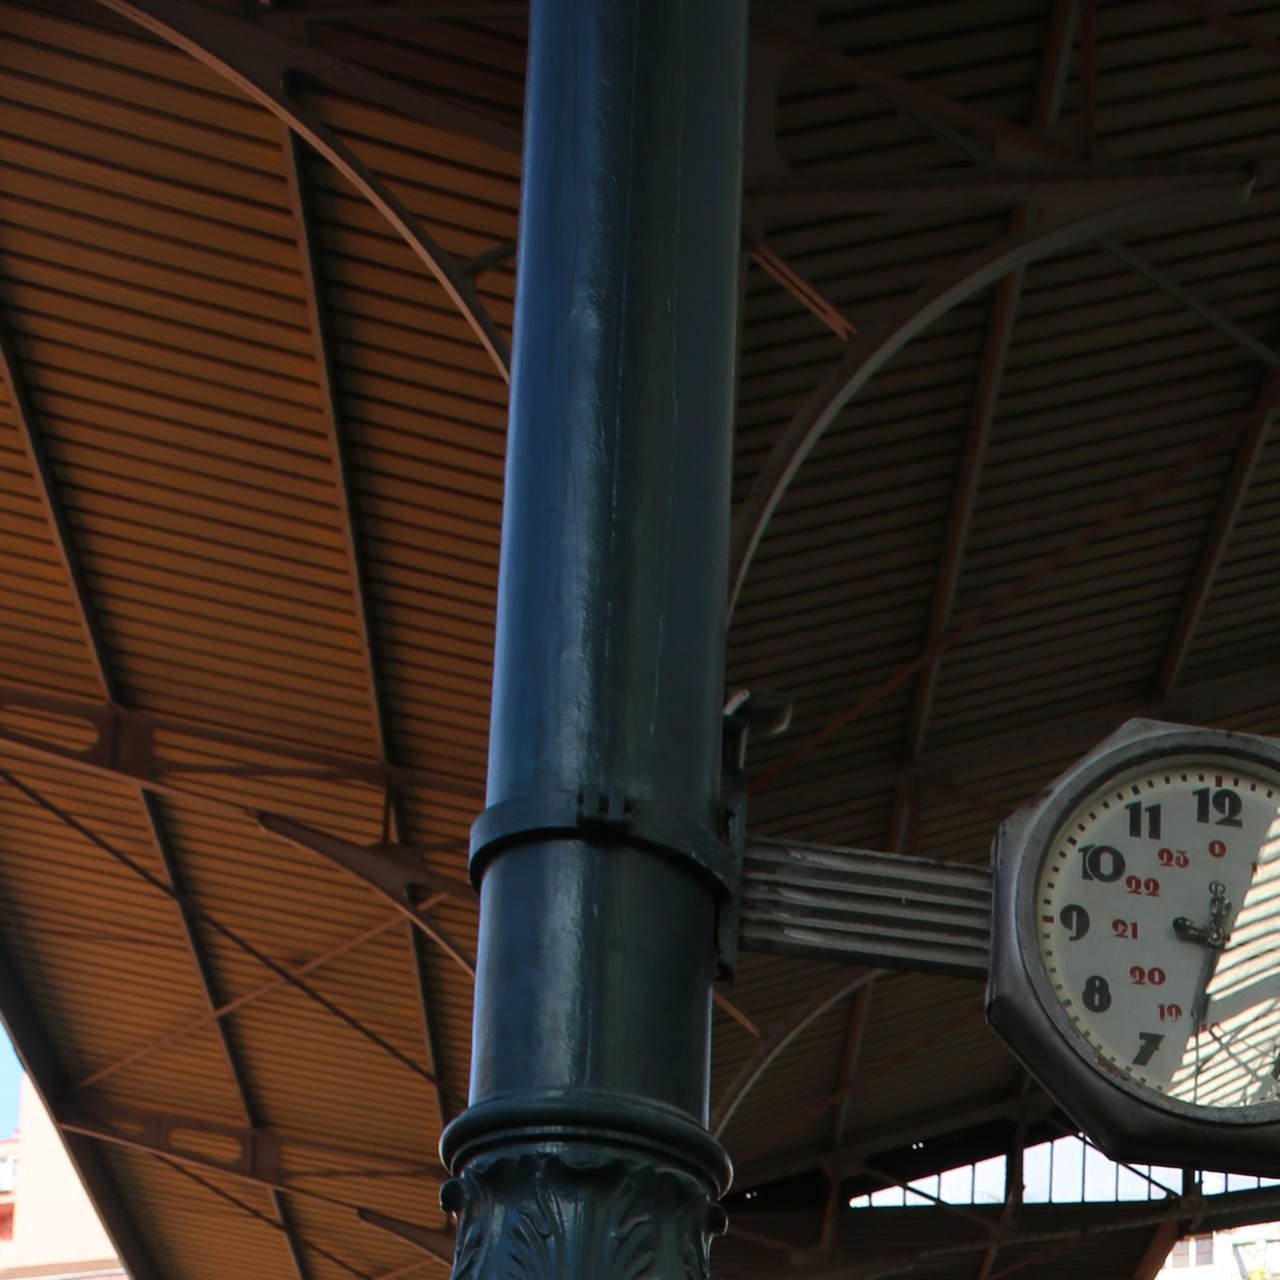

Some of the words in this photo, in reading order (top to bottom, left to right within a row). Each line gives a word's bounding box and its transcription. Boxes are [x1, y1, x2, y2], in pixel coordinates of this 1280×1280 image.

[1124, 801, 1161, 840] 11
[1193, 787, 1242, 827] 12
[1158, 848, 1190, 868] 23
[1208, 840, 1226, 858] 0
[1079, 844, 1126, 883] 10
[1126, 877, 1160, 897] 22
[1060, 904, 1090, 941] 9
[1111, 919, 1138, 940] 21
[1129, 966, 1166, 986] 20
[1082, 976, 1111, 1013] 8
[1158, 1003, 1182, 1022] 19
[1133, 1031, 1166, 1066] 7
